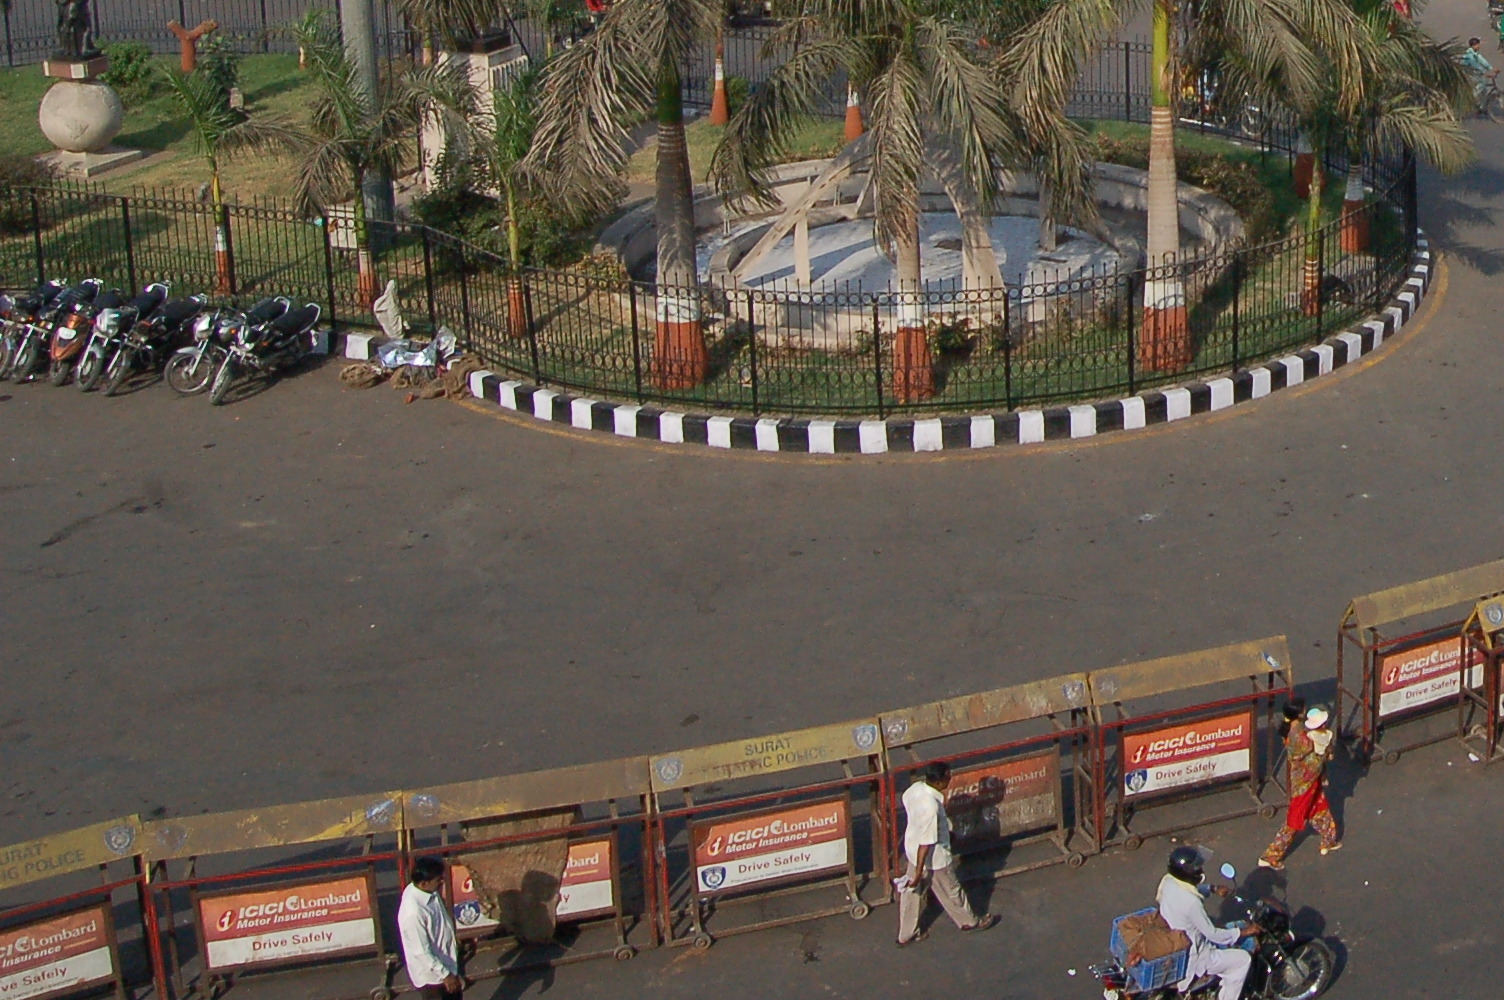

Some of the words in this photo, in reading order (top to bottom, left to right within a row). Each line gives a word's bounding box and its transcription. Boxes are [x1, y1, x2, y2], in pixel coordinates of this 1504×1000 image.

[1400, 656, 1430, 674] ICICI
[1405, 686, 1429, 700] Drive
[1431, 678, 1458, 692] Safely
[744, 737, 793, 756] SURAT
[1148, 737, 1184, 753] ICICI
[1196, 725, 1243, 743] Lombard
[1155, 768, 1183, 781] Drive
[1186, 761, 1217, 774] Safely
[728, 826, 769, 844] ICICI
[783, 812, 838, 833] Lombard
[726, 842, 757, 854] Motor
[758, 832, 808, 847] Insurance
[0, 843, 42, 866] URAT
[25, 850, 86, 874] POLICE
[567, 853, 599, 868] bard
[738, 860, 770, 874] Drive
[774, 852, 811, 866] Safely
[238, 902, 284, 919] ICICI
[300, 889, 361, 909] Lombard
[236, 918, 271, 930] Motor
[273, 908, 329, 924] Insurance
[30, 920, 97, 949] Lombard
[252, 937, 288, 952] Drive
[292, 930, 333, 945] Safely
[3, 944, 62, 968] Insurance
[22, 967, 68, 985] Safely
